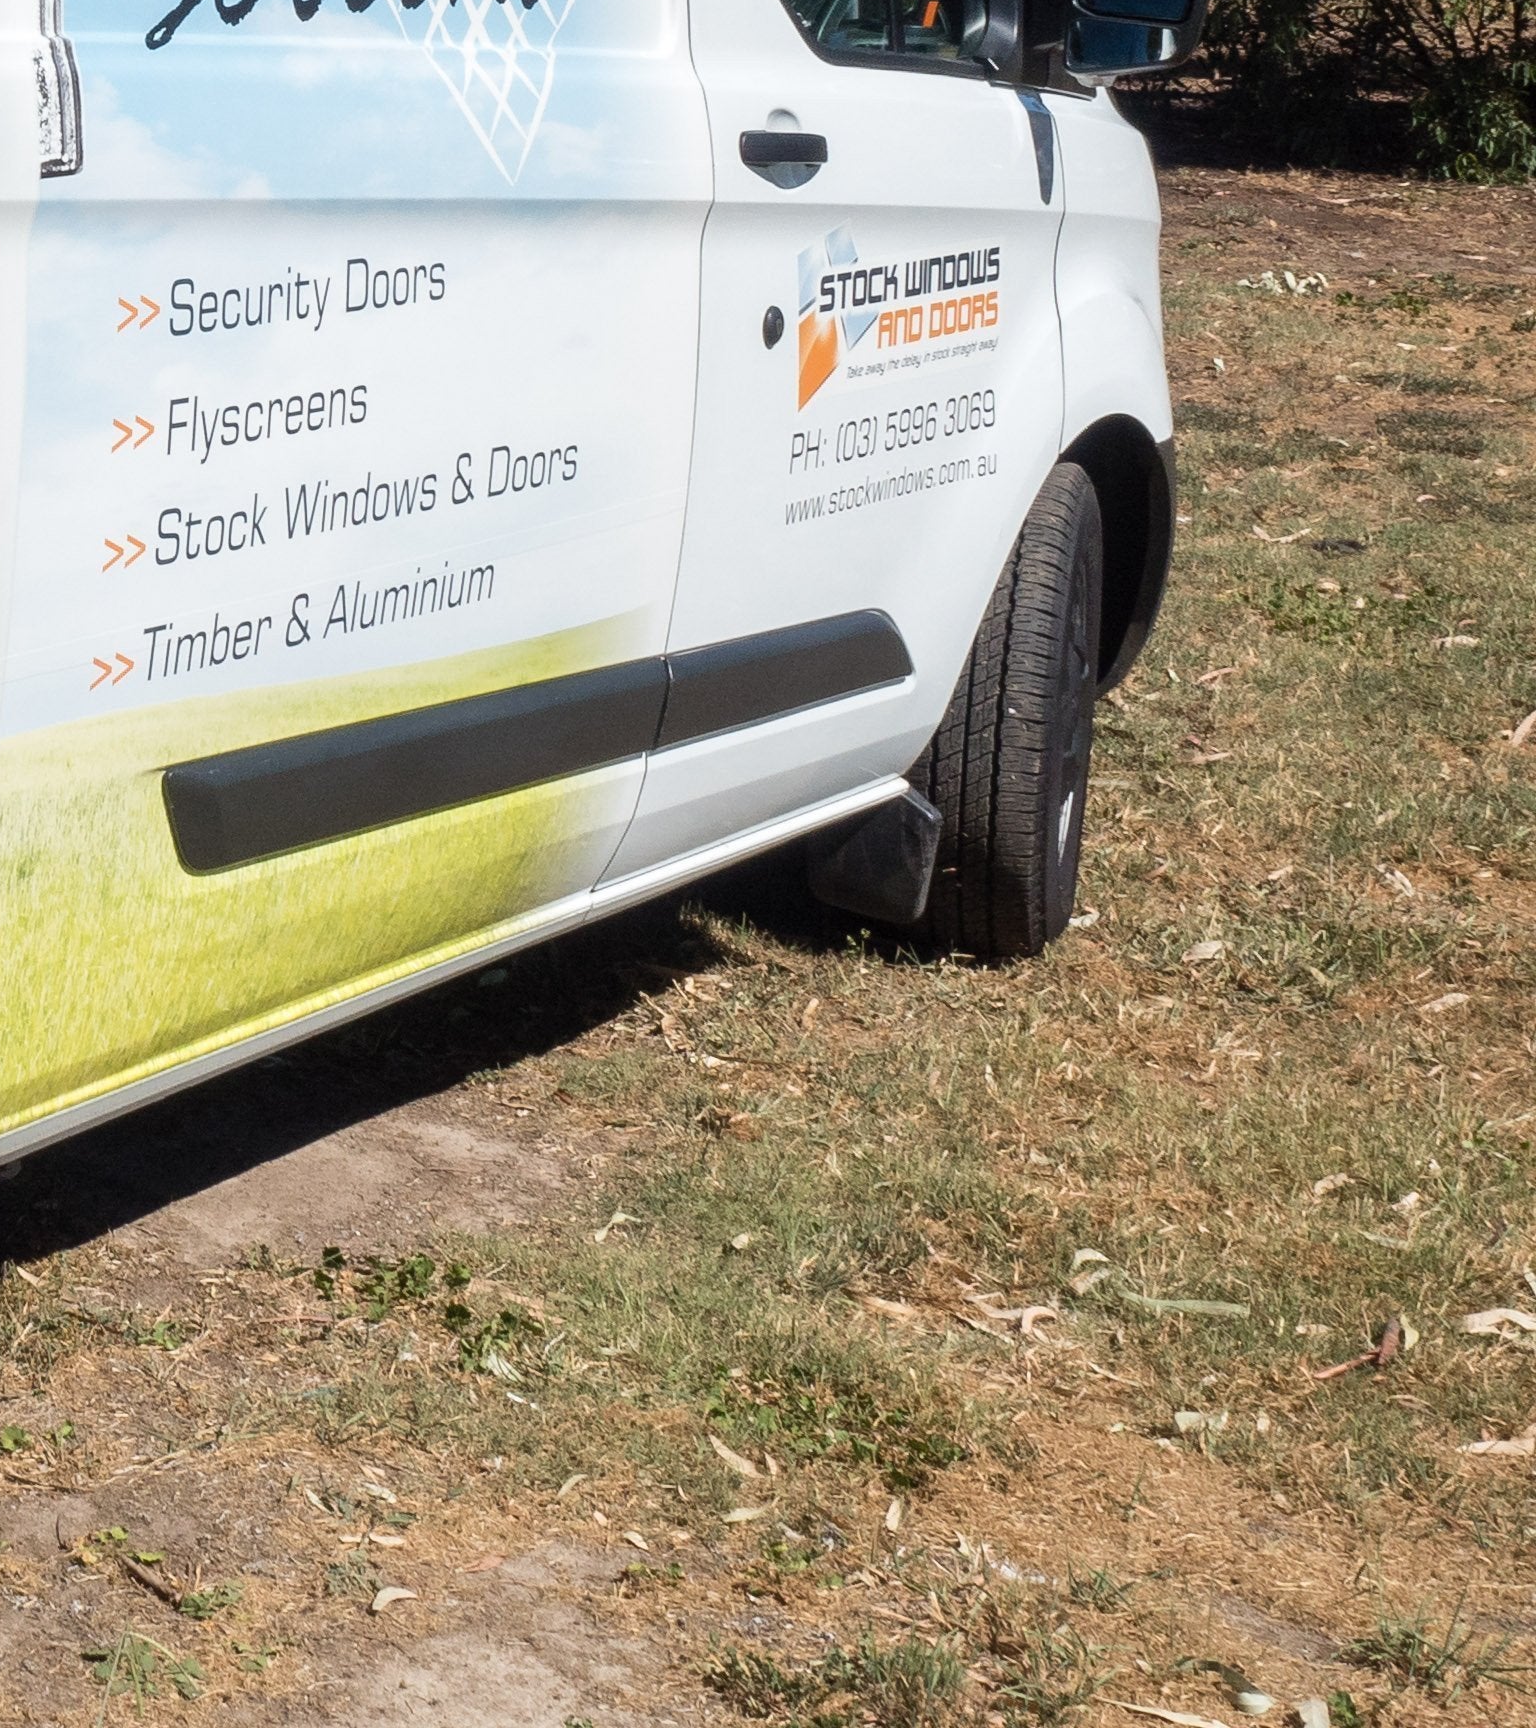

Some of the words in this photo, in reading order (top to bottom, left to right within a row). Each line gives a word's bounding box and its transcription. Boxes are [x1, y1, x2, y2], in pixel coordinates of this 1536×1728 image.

[169, 266, 330, 337] Security
[344, 257, 446, 314] Doors
[819, 264, 898, 313] STOCK
[928, 291, 998, 339] DOORS
[166, 383, 368, 465] Flyscreens
[789, 428, 828, 475] PH:
[835, 415, 878, 464] (03)
[884, 401, 938, 452] 5996
[943, 388, 996, 437] 3069
[154, 493, 268, 566] Stock
[284, 470, 438, 540] Windows
[451, 452, 476, 506] &
[487, 443, 579, 498] Doors
[142, 611, 273, 682] Timber
[285, 592, 311, 648] &
[323, 560, 495, 639] Aluminium
